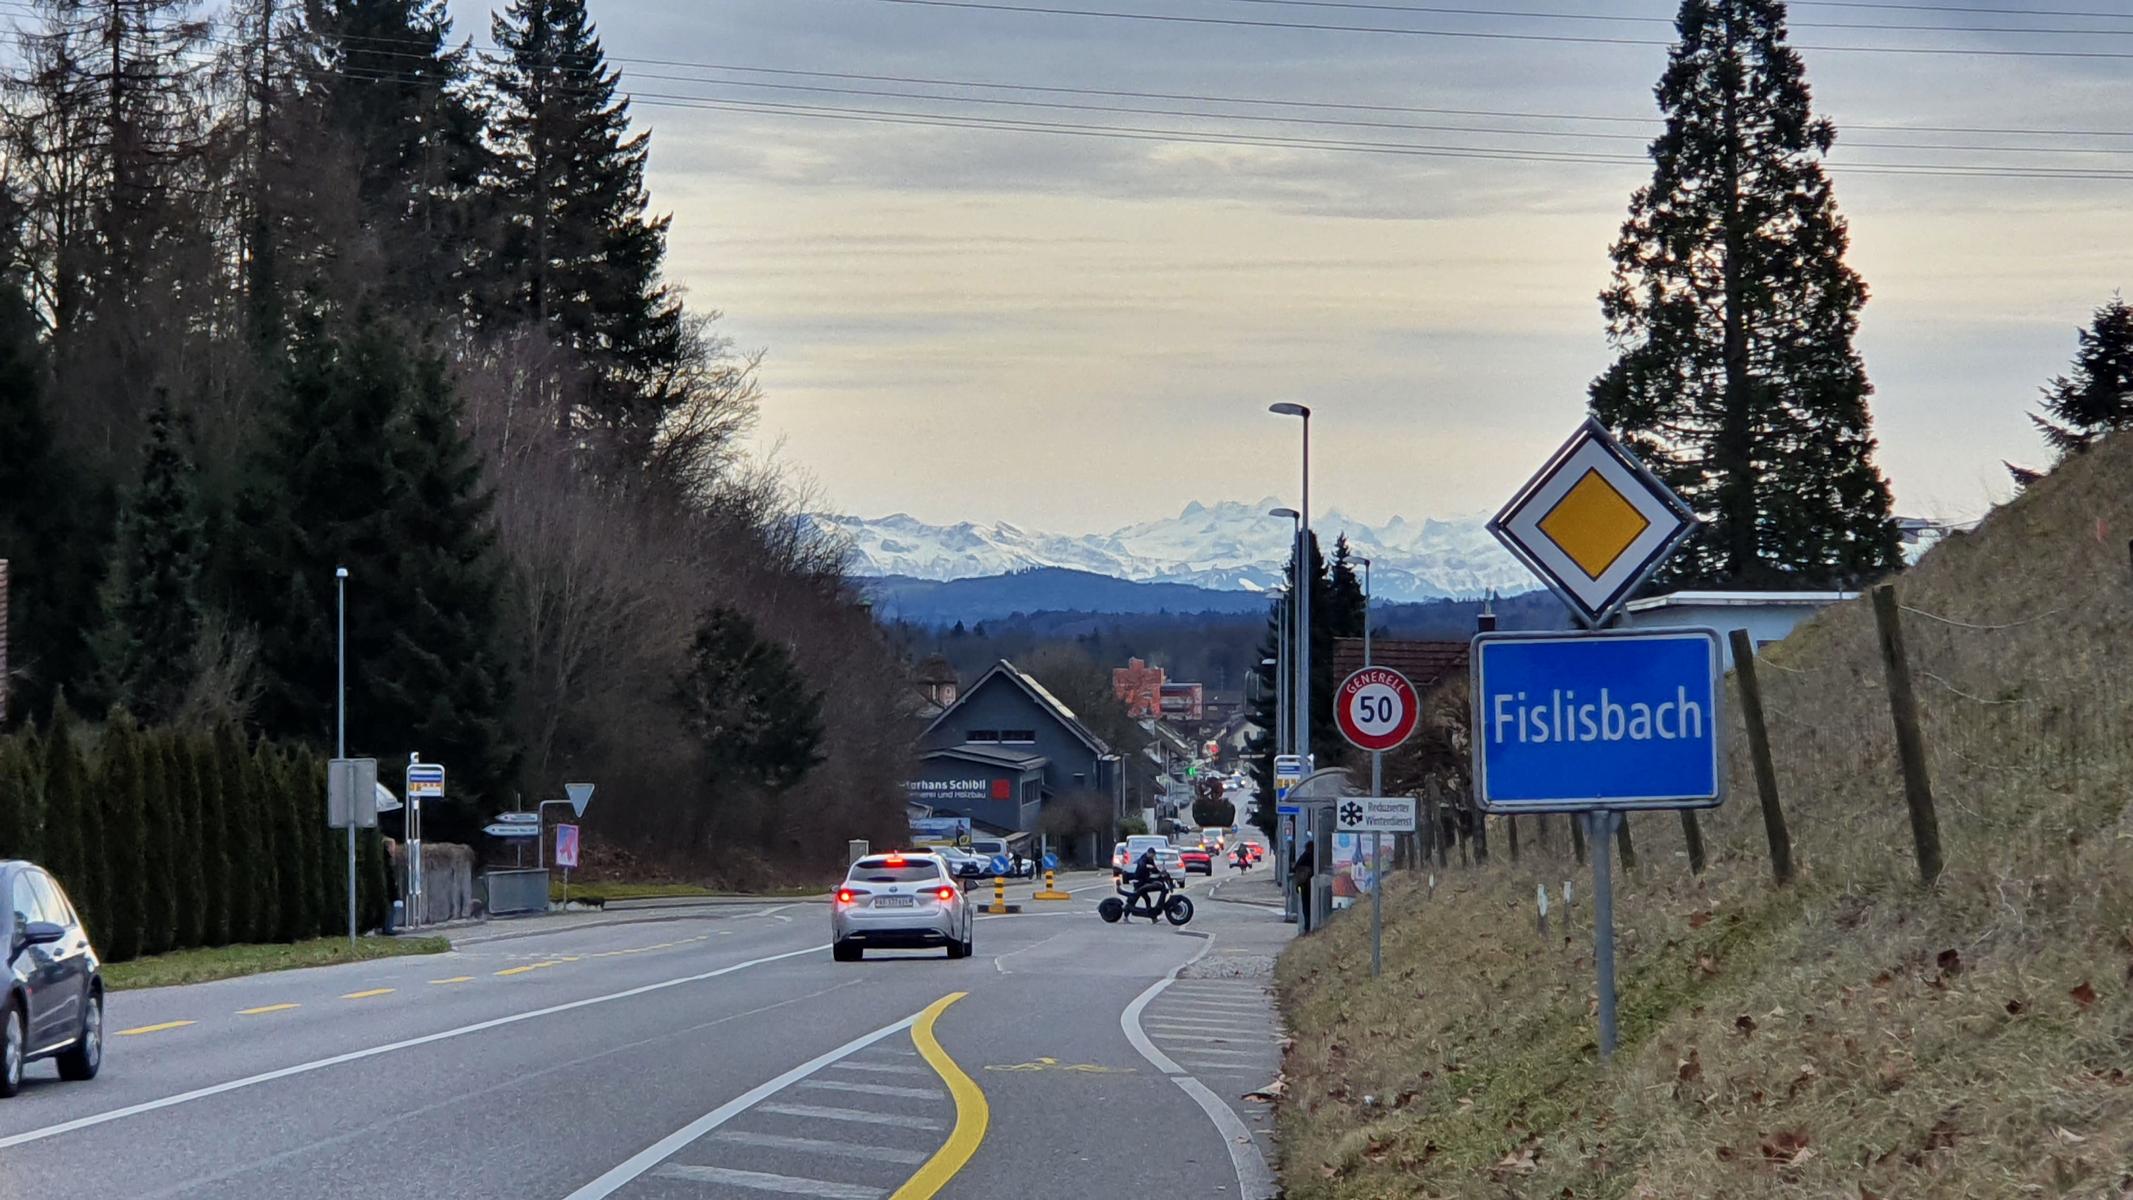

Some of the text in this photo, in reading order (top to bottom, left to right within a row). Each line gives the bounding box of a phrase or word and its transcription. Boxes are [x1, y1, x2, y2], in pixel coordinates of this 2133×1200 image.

[1345, 671, 1405, 694] GENERELL
[1360, 695, 1393, 723] 50
[1494, 685, 1702, 744] Fislisbach
